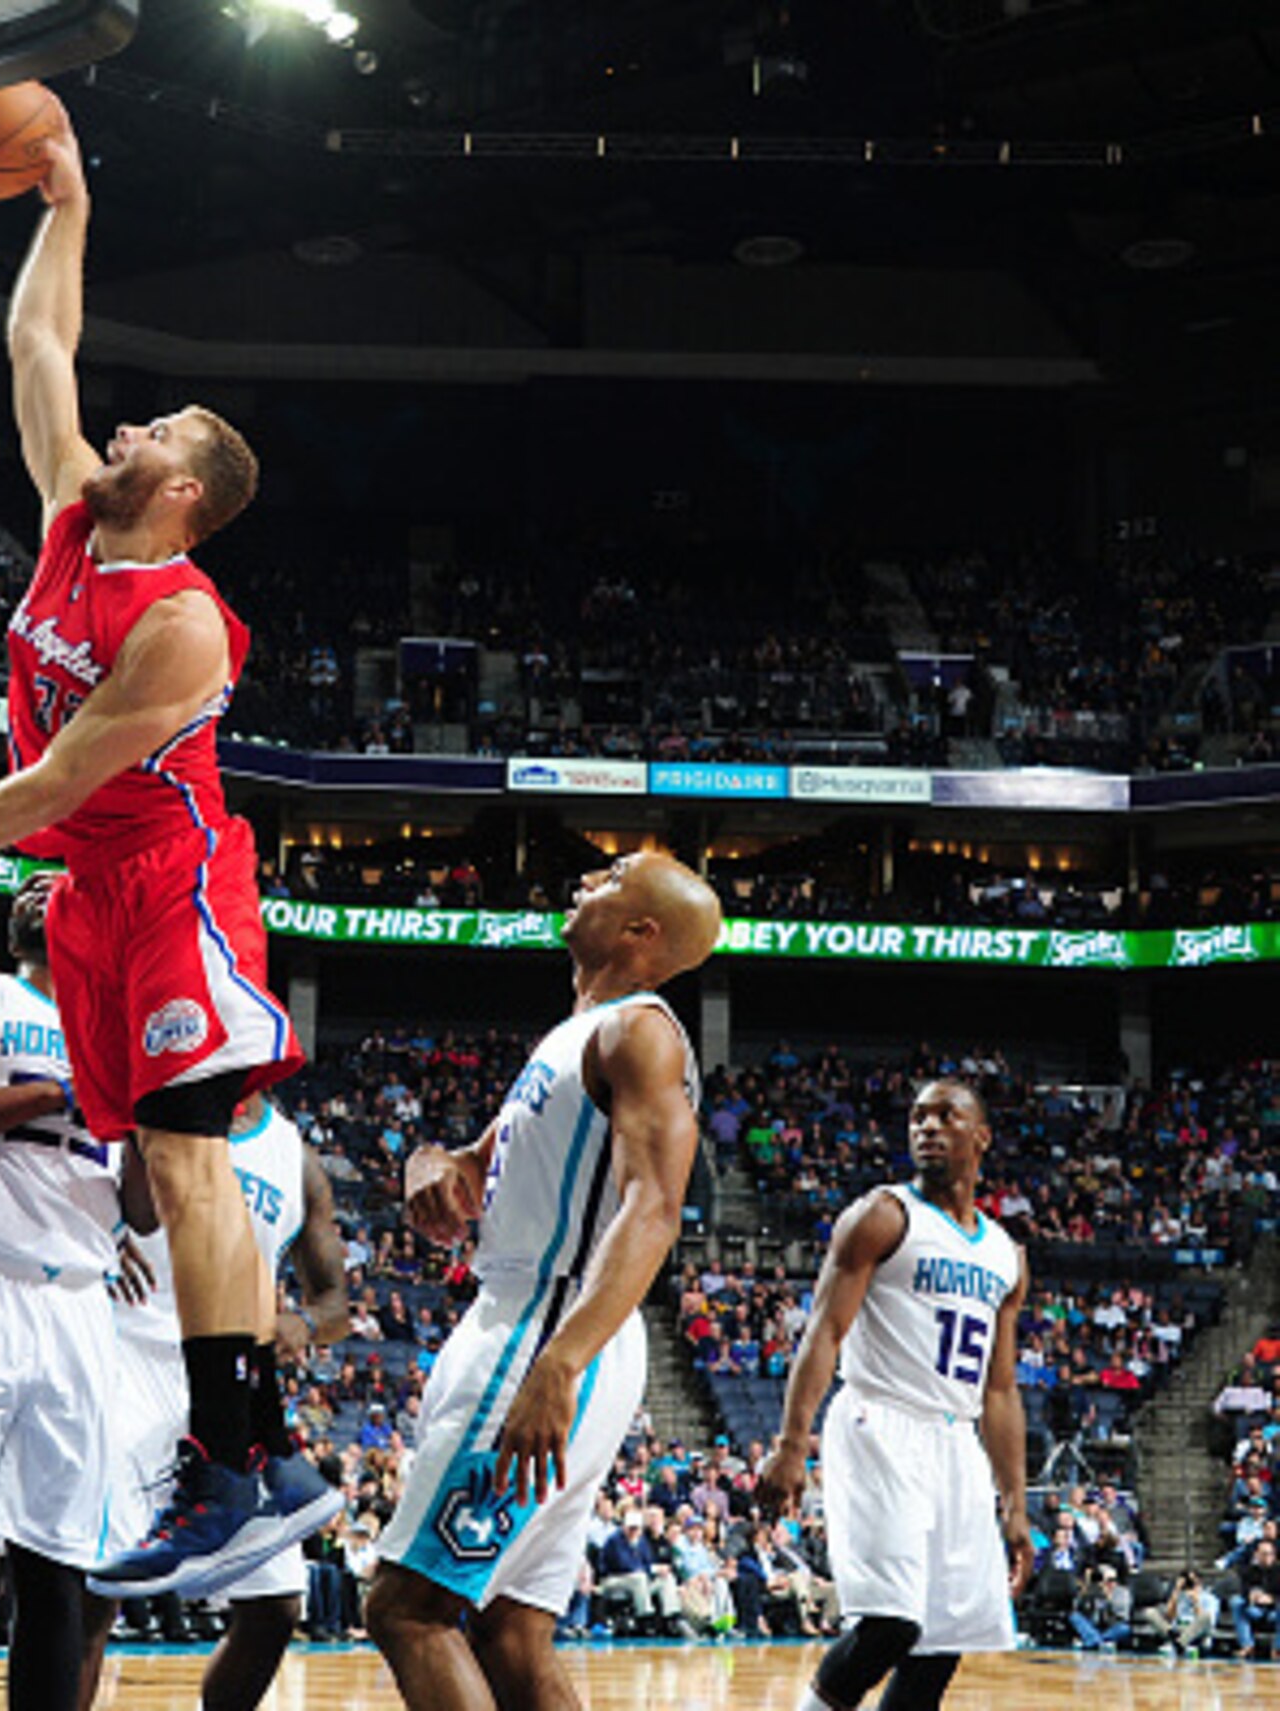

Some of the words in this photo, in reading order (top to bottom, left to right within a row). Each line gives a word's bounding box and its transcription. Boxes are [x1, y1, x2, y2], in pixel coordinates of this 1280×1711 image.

[654, 769, 779, 791] FRIGIDAIRE
[344, 908, 472, 940] THIRST
[804, 922, 906, 954] YOUR
[912, 925, 1039, 961] THIRST
[0, 1020, 67, 1060] HOR
[233, 1166, 284, 1226] ETS
[913, 1257, 1011, 1312] HORNET
[934, 1305, 988, 1386] 15
